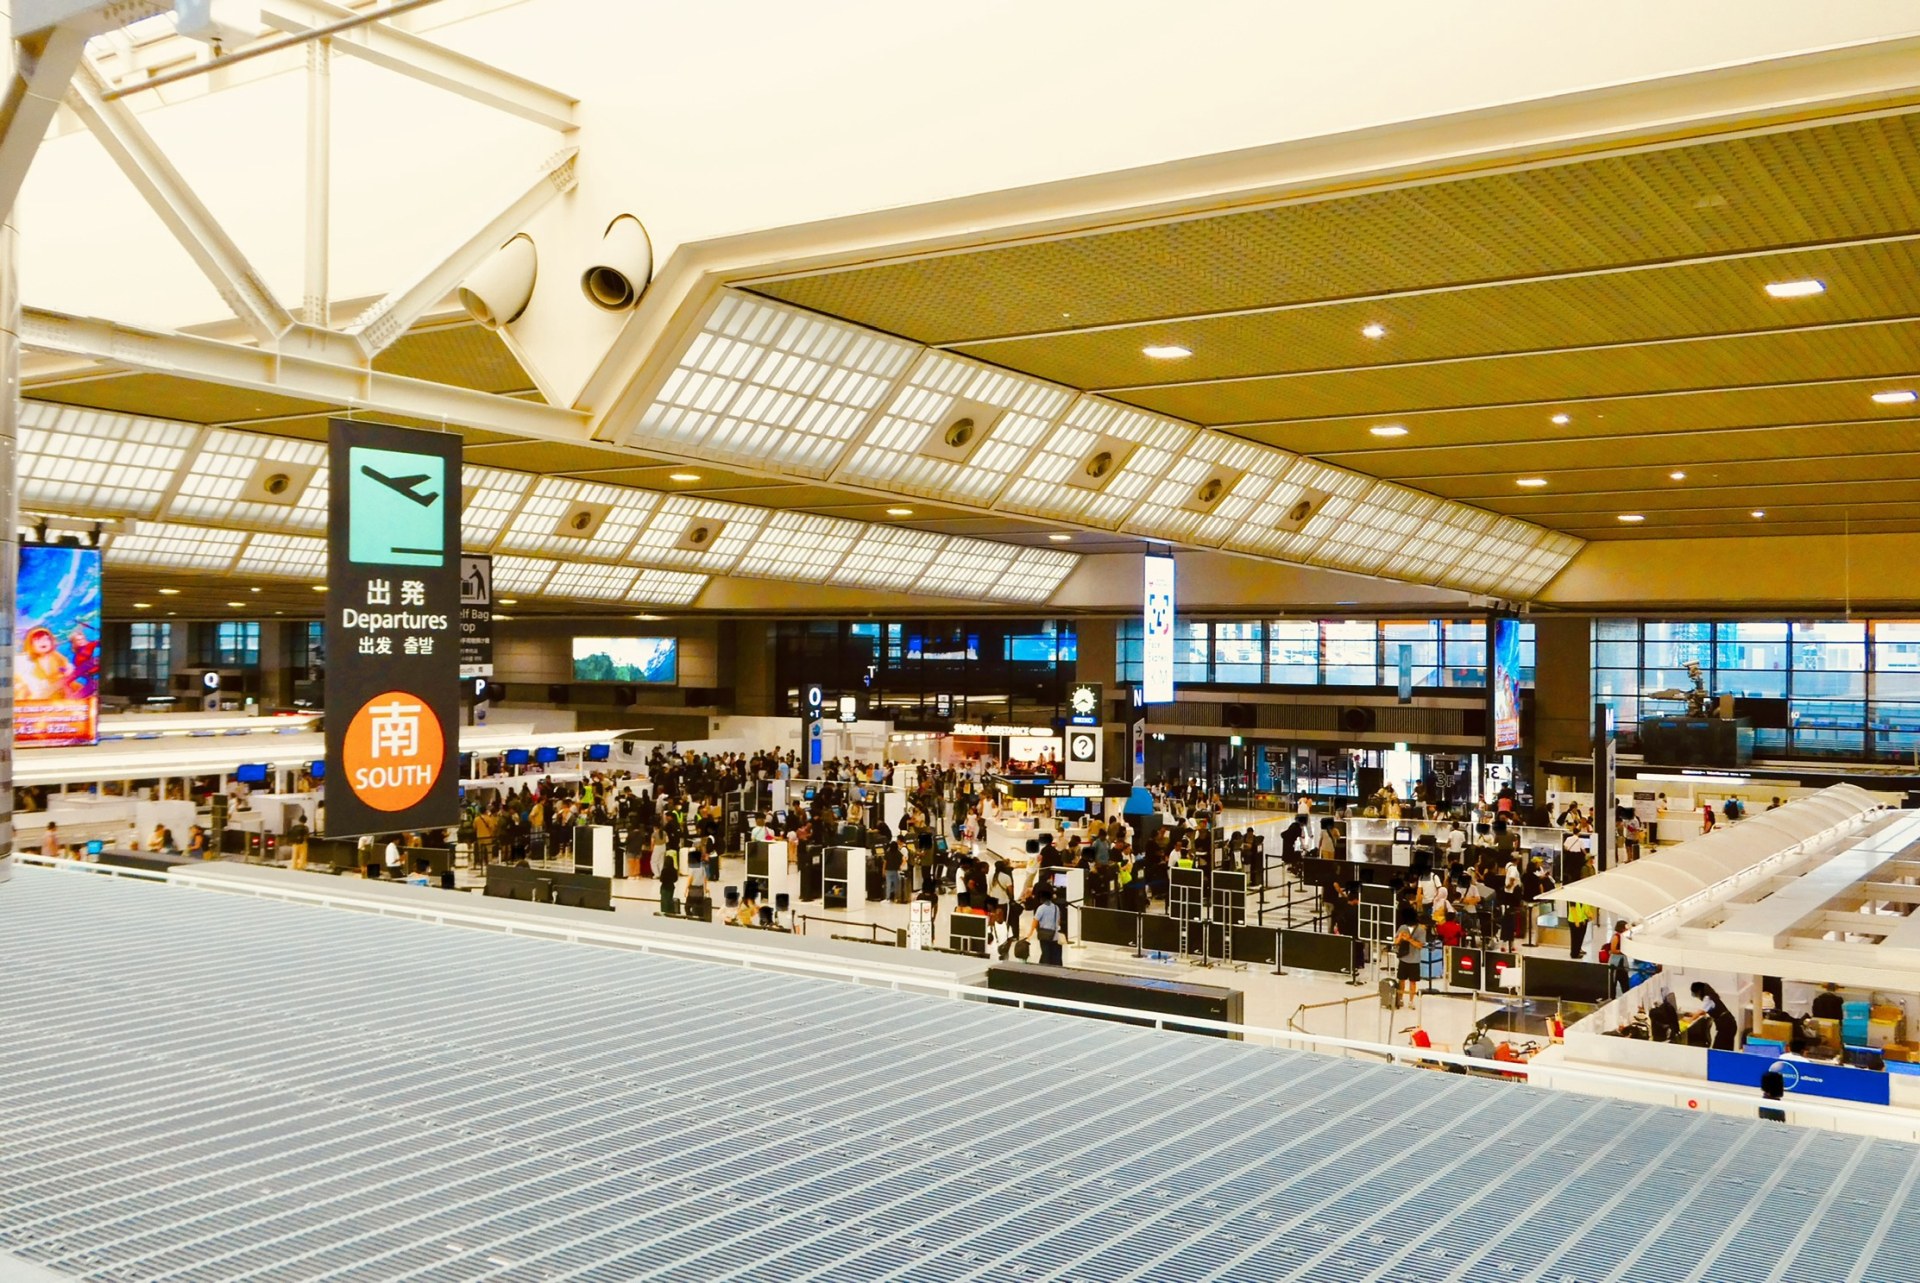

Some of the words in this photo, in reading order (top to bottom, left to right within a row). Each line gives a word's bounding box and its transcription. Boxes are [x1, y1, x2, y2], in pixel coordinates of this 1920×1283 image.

[366, 578, 426, 606] 出発
[342, 608, 448, 633] Departures
[471, 609, 490, 622] Bag
[358, 635, 393, 655] 出发
[403, 635, 435, 655] 출발
[203, 672, 219, 689] Q
[475, 679, 486, 696] P
[1133, 689, 1142, 707] N
[368, 701, 422, 758] 南
[355, 764, 432, 790] SOUTH
[1435, 772, 1456, 788] 3F
